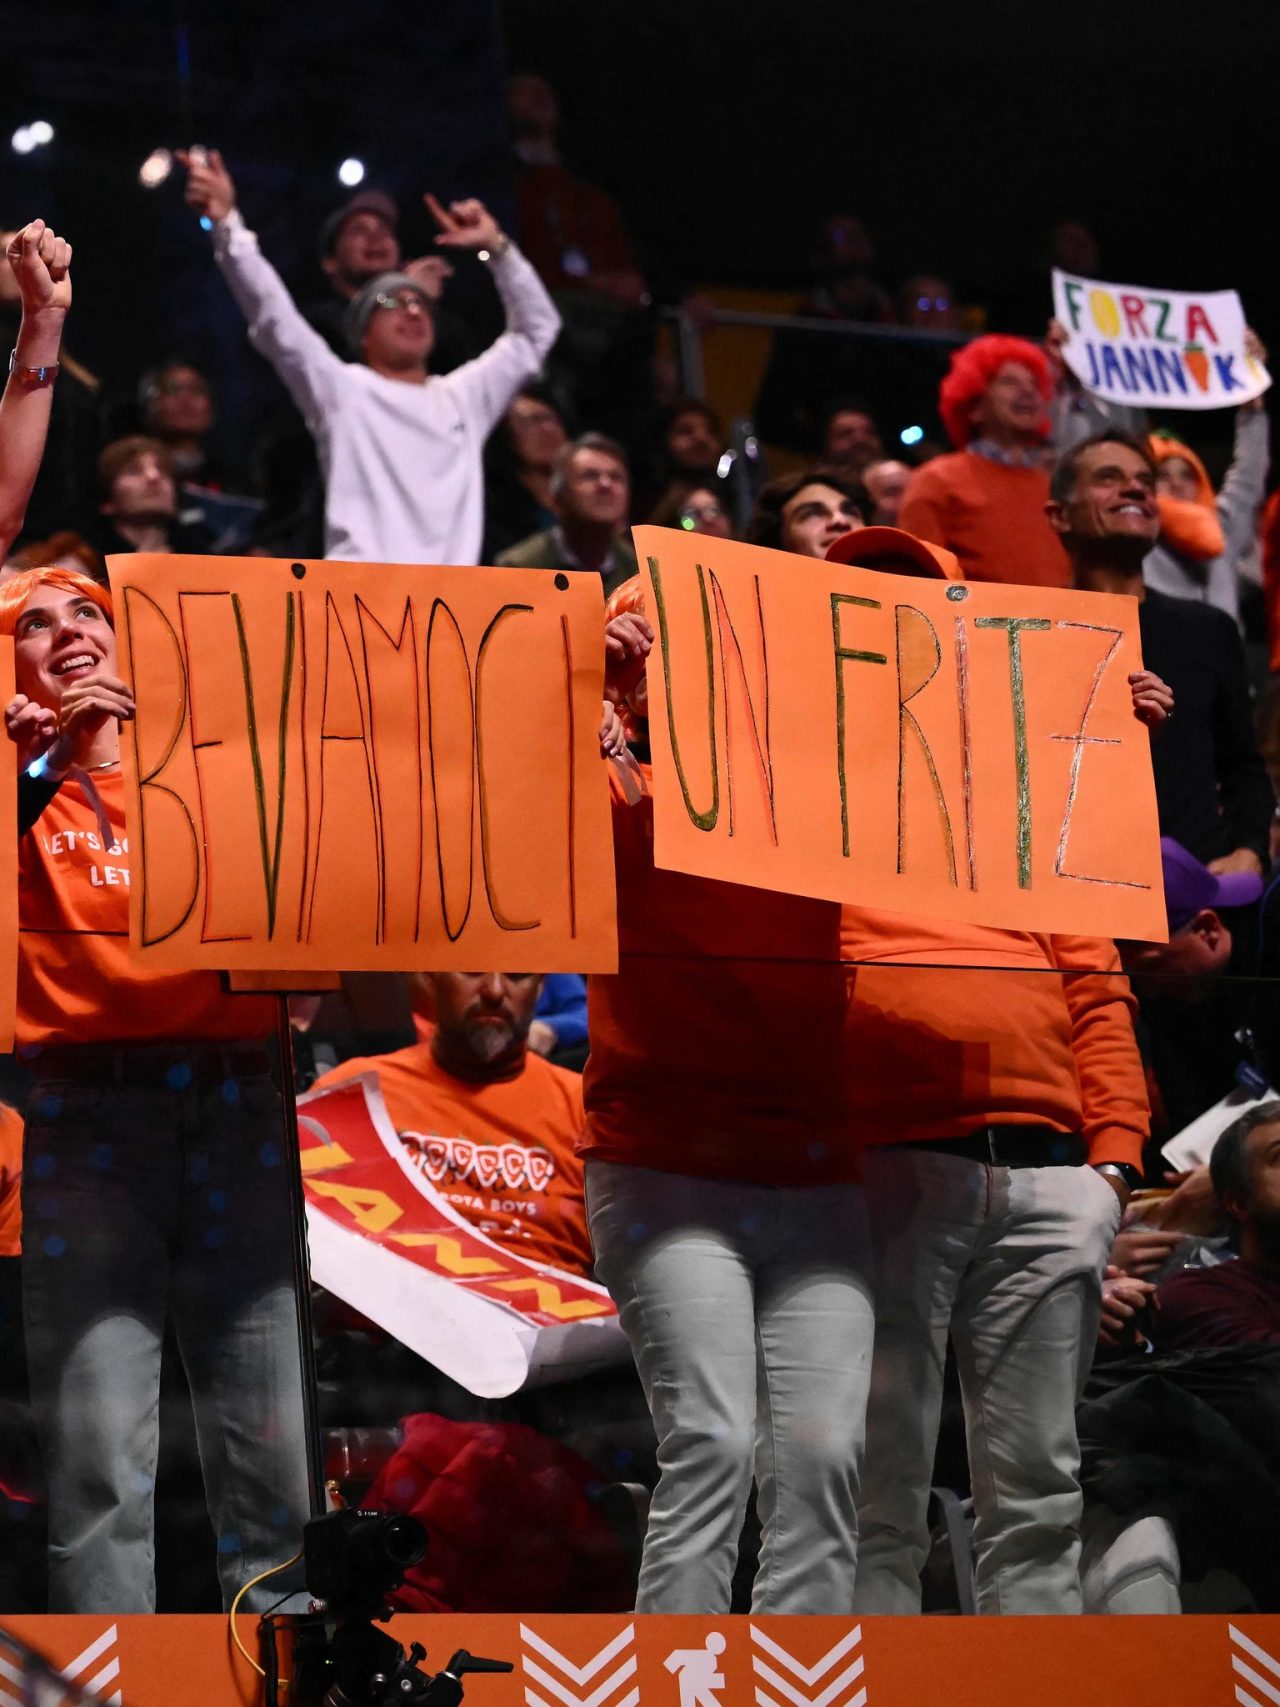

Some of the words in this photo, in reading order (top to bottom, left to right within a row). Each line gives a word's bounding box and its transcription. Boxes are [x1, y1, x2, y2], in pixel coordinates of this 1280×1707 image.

[1064, 281, 1219, 346] FORZA
[122, 563, 578, 948] BEVIAMOCI
[647, 556, 779, 848] UN
[830, 584, 1152, 892] FRITZ
[489, 1198, 537, 1216] BOYS
